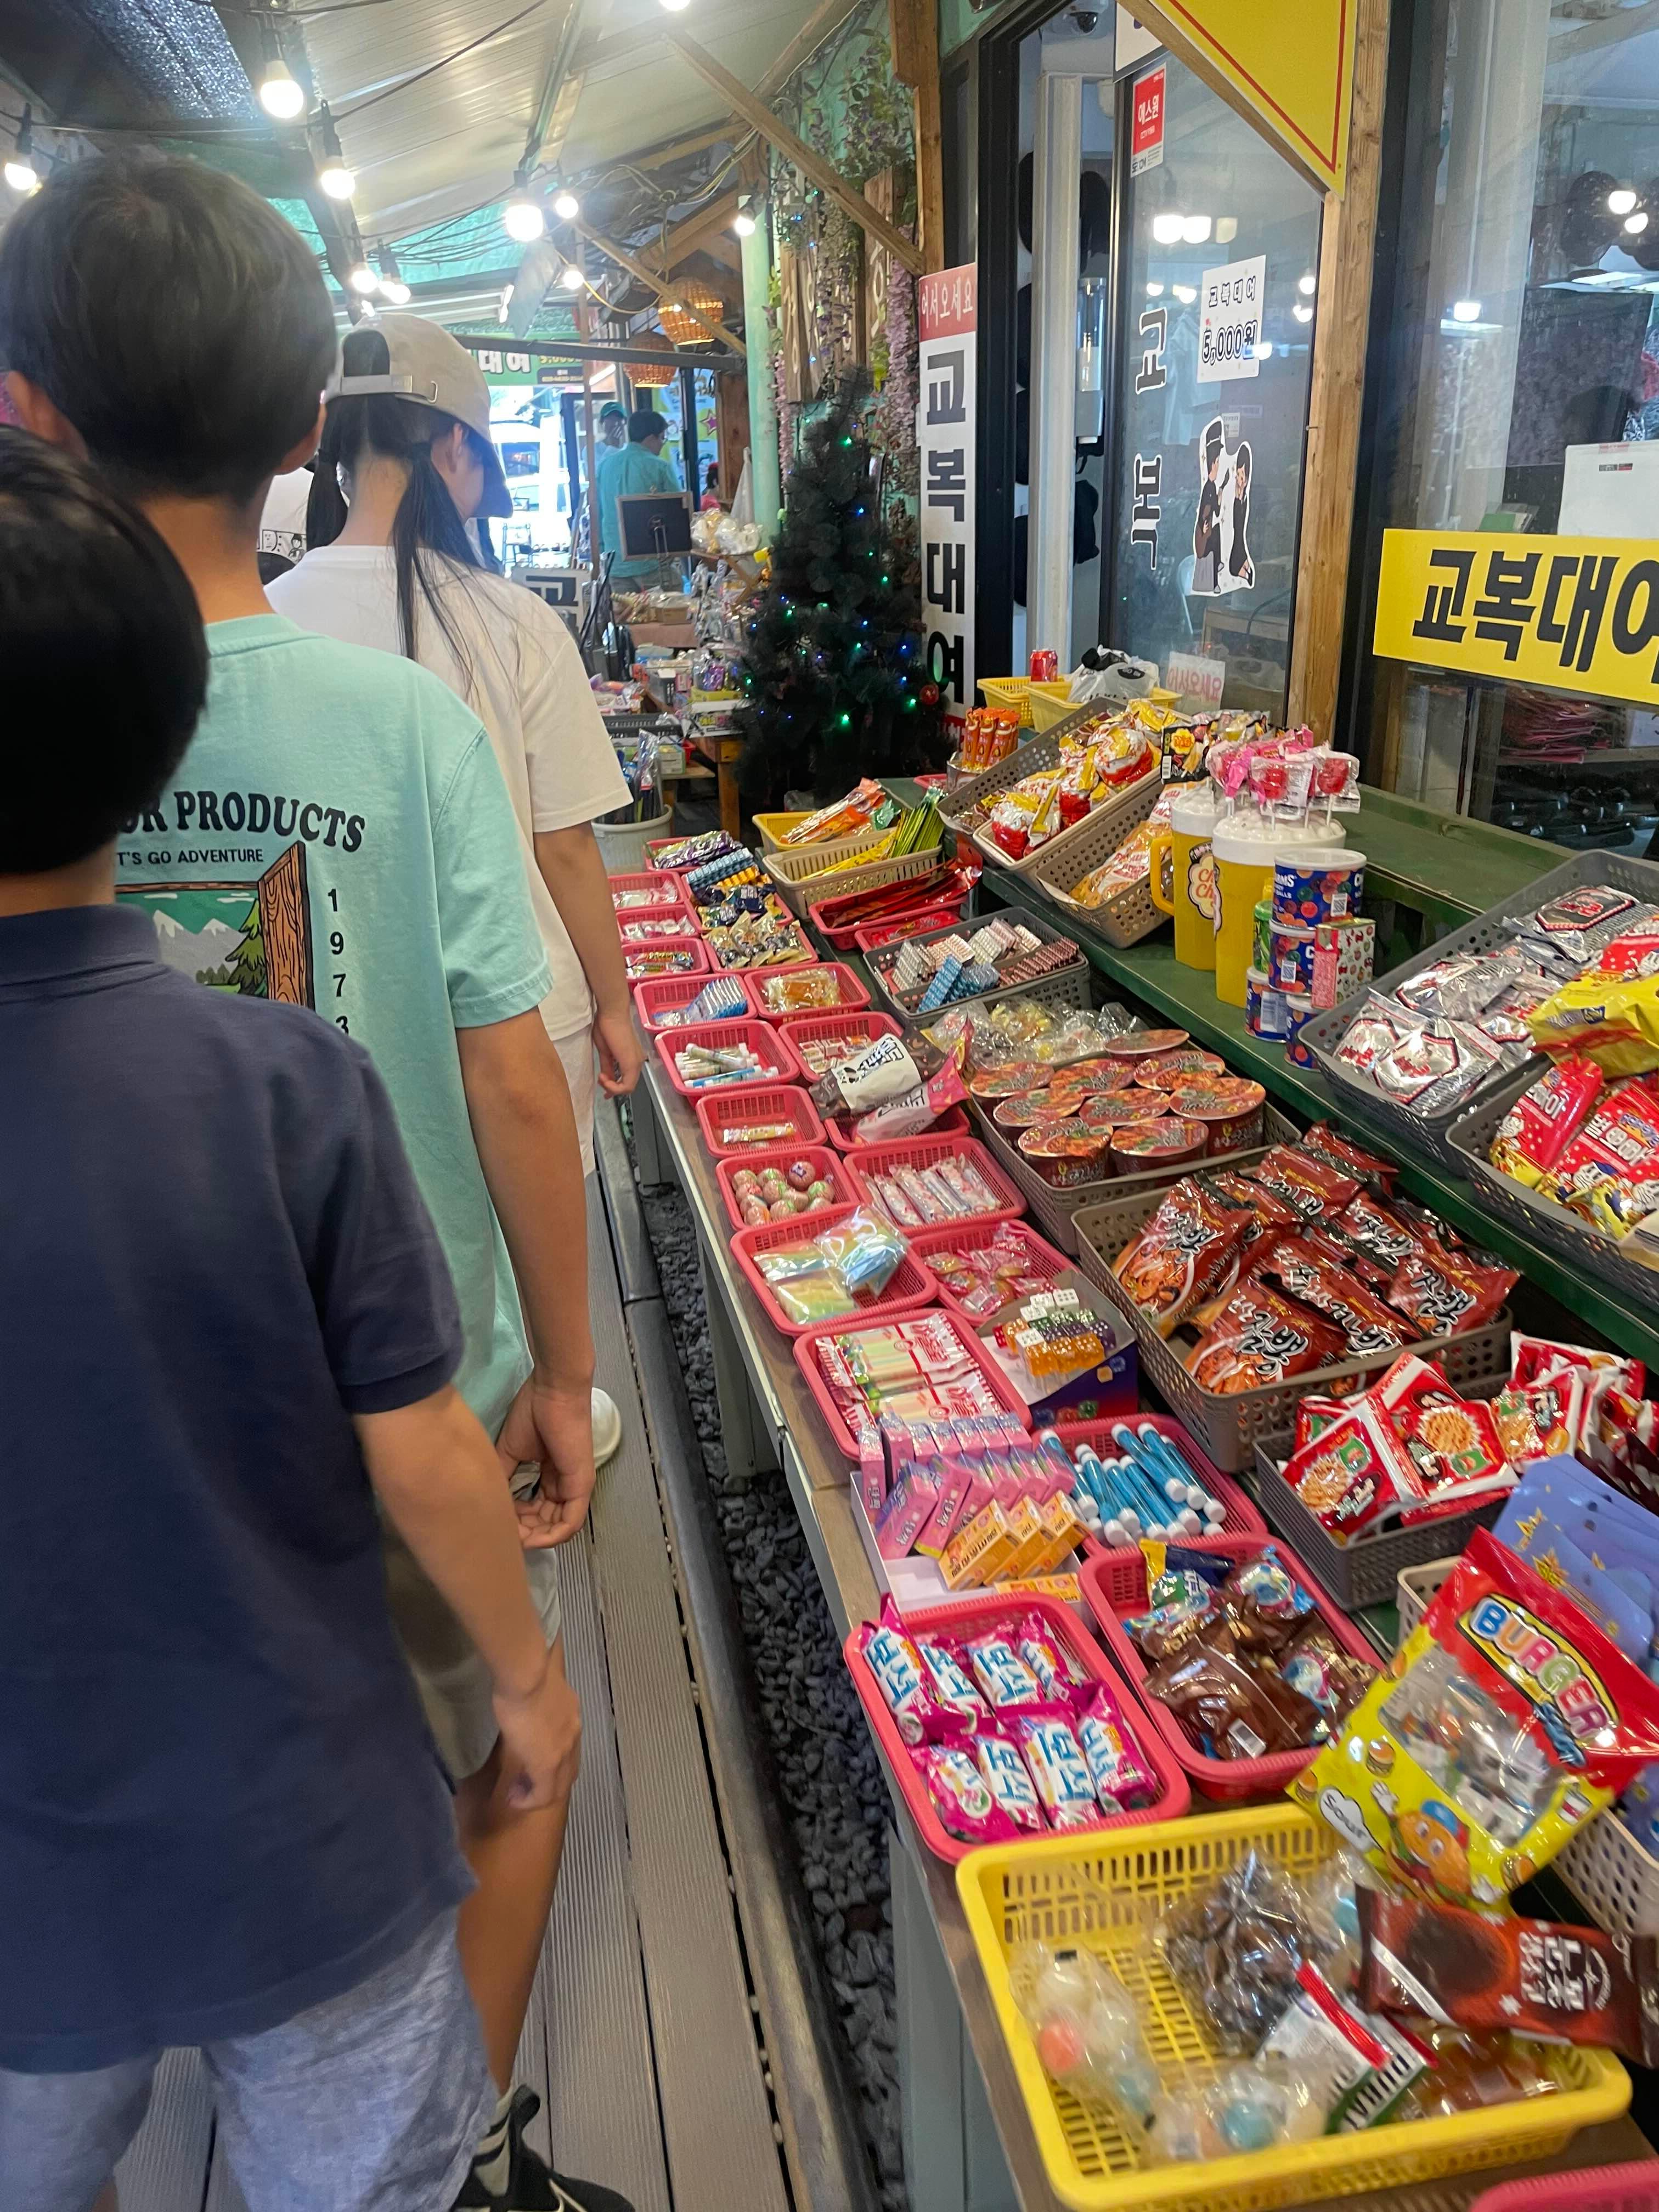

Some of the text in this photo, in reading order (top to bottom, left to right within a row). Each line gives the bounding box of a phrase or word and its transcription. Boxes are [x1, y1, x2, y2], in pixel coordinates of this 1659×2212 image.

[1138, 94, 1159, 125] 에스원
[922, 276, 974, 329] 어서오세요
[1208, 275, 1256, 308] 교복대여
[1203, 319, 1258, 366] 5,000원
[926, 349, 966, 704] 교복대여
[174, 791, 365, 853] PRODUCTS
[148, 850, 172, 864] GO
[177, 849, 264, 864] ADVENTURE
[1470, 1598, 1612, 1739] BURGER
[1323, 1792, 1366, 1842] Sour
